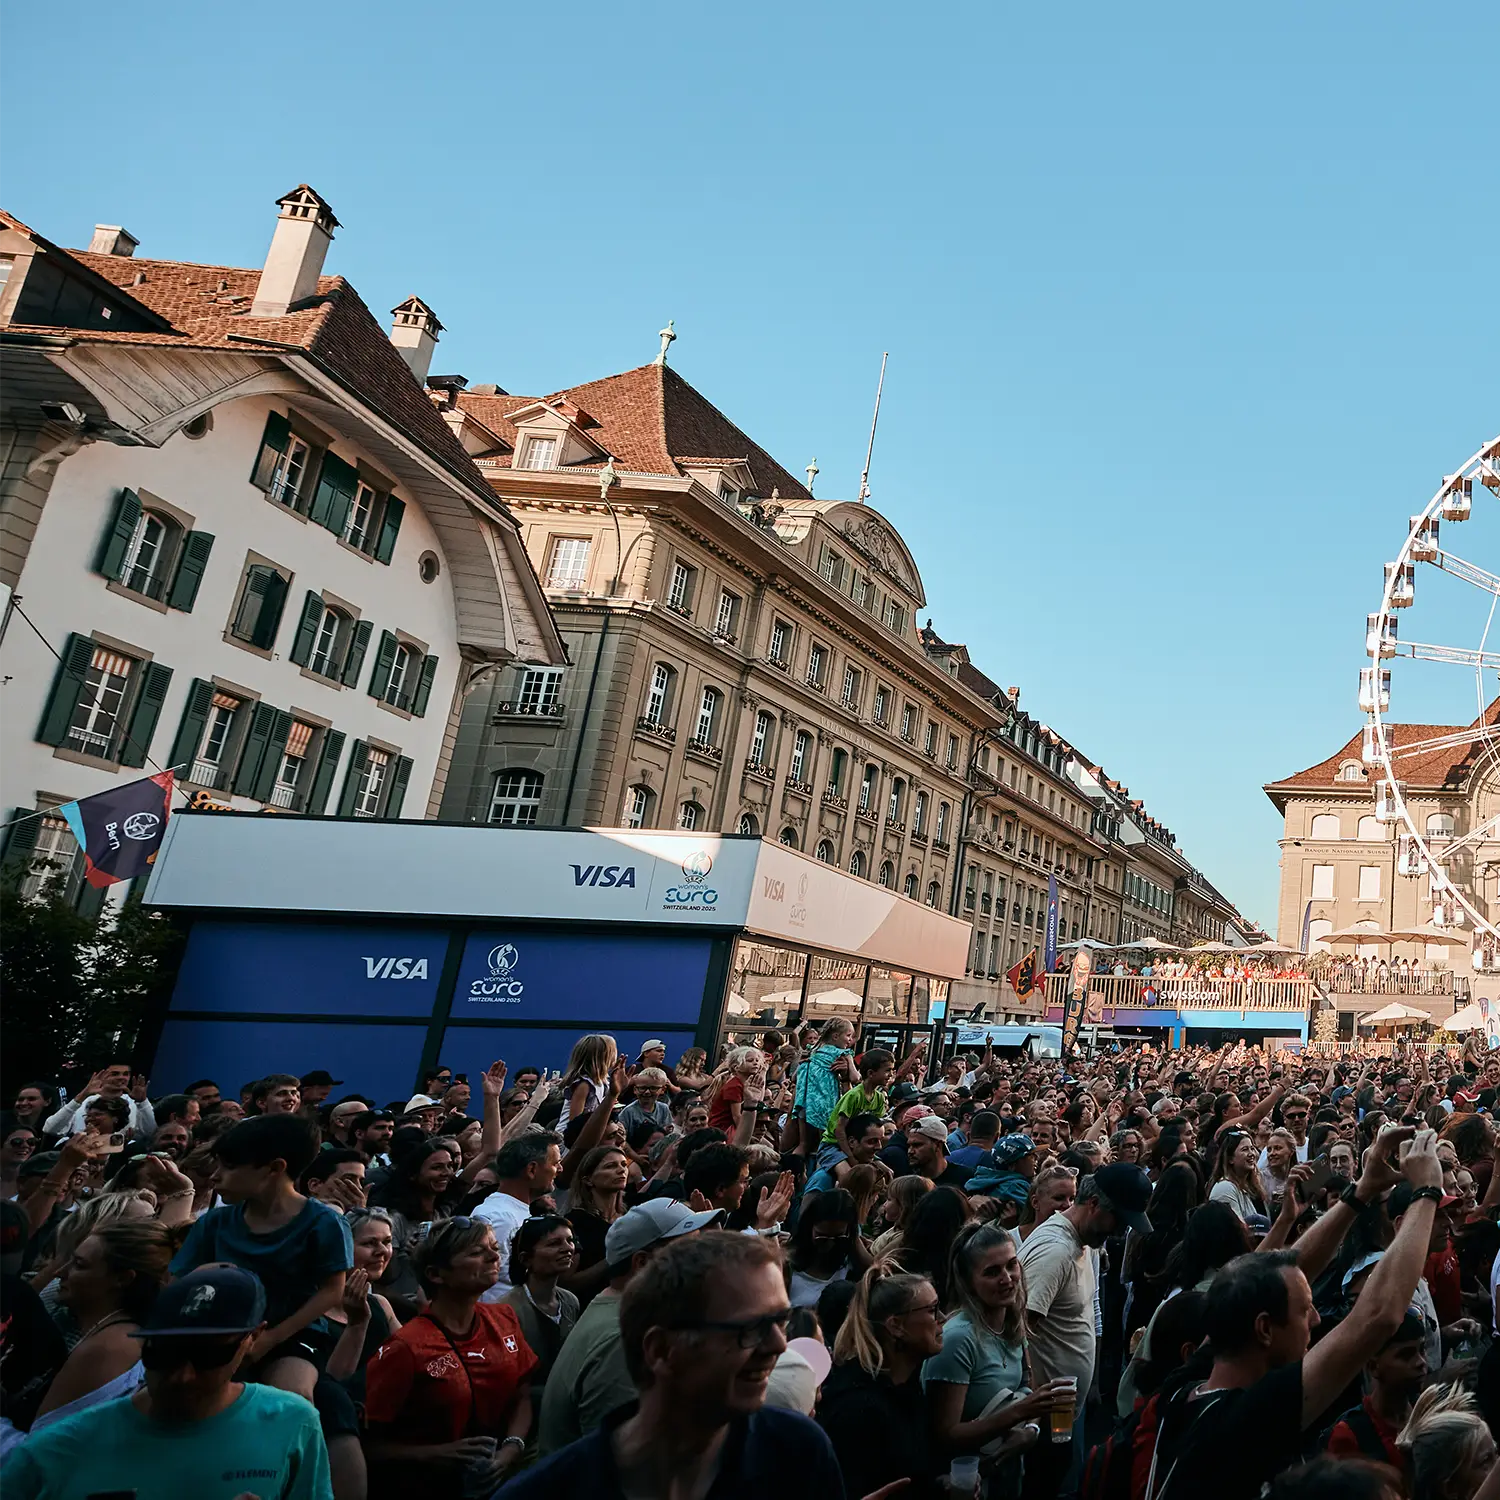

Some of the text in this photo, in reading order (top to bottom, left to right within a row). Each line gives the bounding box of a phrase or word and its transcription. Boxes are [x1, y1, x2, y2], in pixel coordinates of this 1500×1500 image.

[105, 821, 120, 850] Bern
[568, 864, 636, 889] VISA
[685, 875, 705, 885] UEFA
[763, 875, 785, 903] VISA
[360, 956, 428, 980] VISA
[490, 967, 511, 977] UEFA
[1159, 988, 1220, 1001] swisscom
[235, 1468, 278, 1480] ELEMENT
